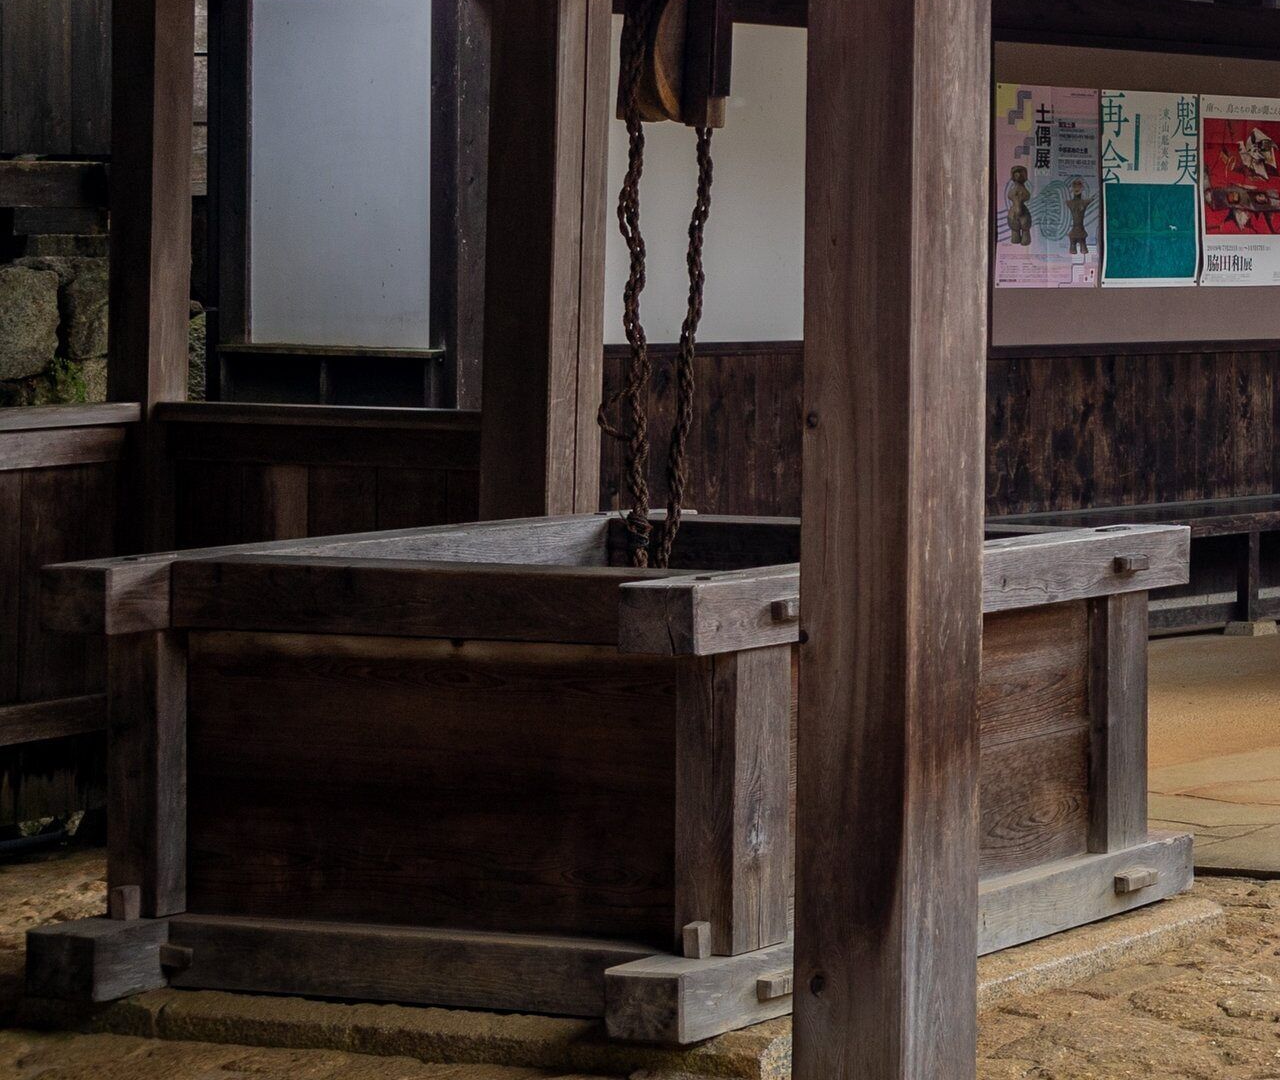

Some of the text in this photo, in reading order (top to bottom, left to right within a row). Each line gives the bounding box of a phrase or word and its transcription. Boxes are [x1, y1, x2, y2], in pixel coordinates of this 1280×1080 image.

[1035, 103, 1051, 169] 土偶展
[1102, 92, 1130, 184] 再会
[1171, 96, 1198, 185] 魁夷
